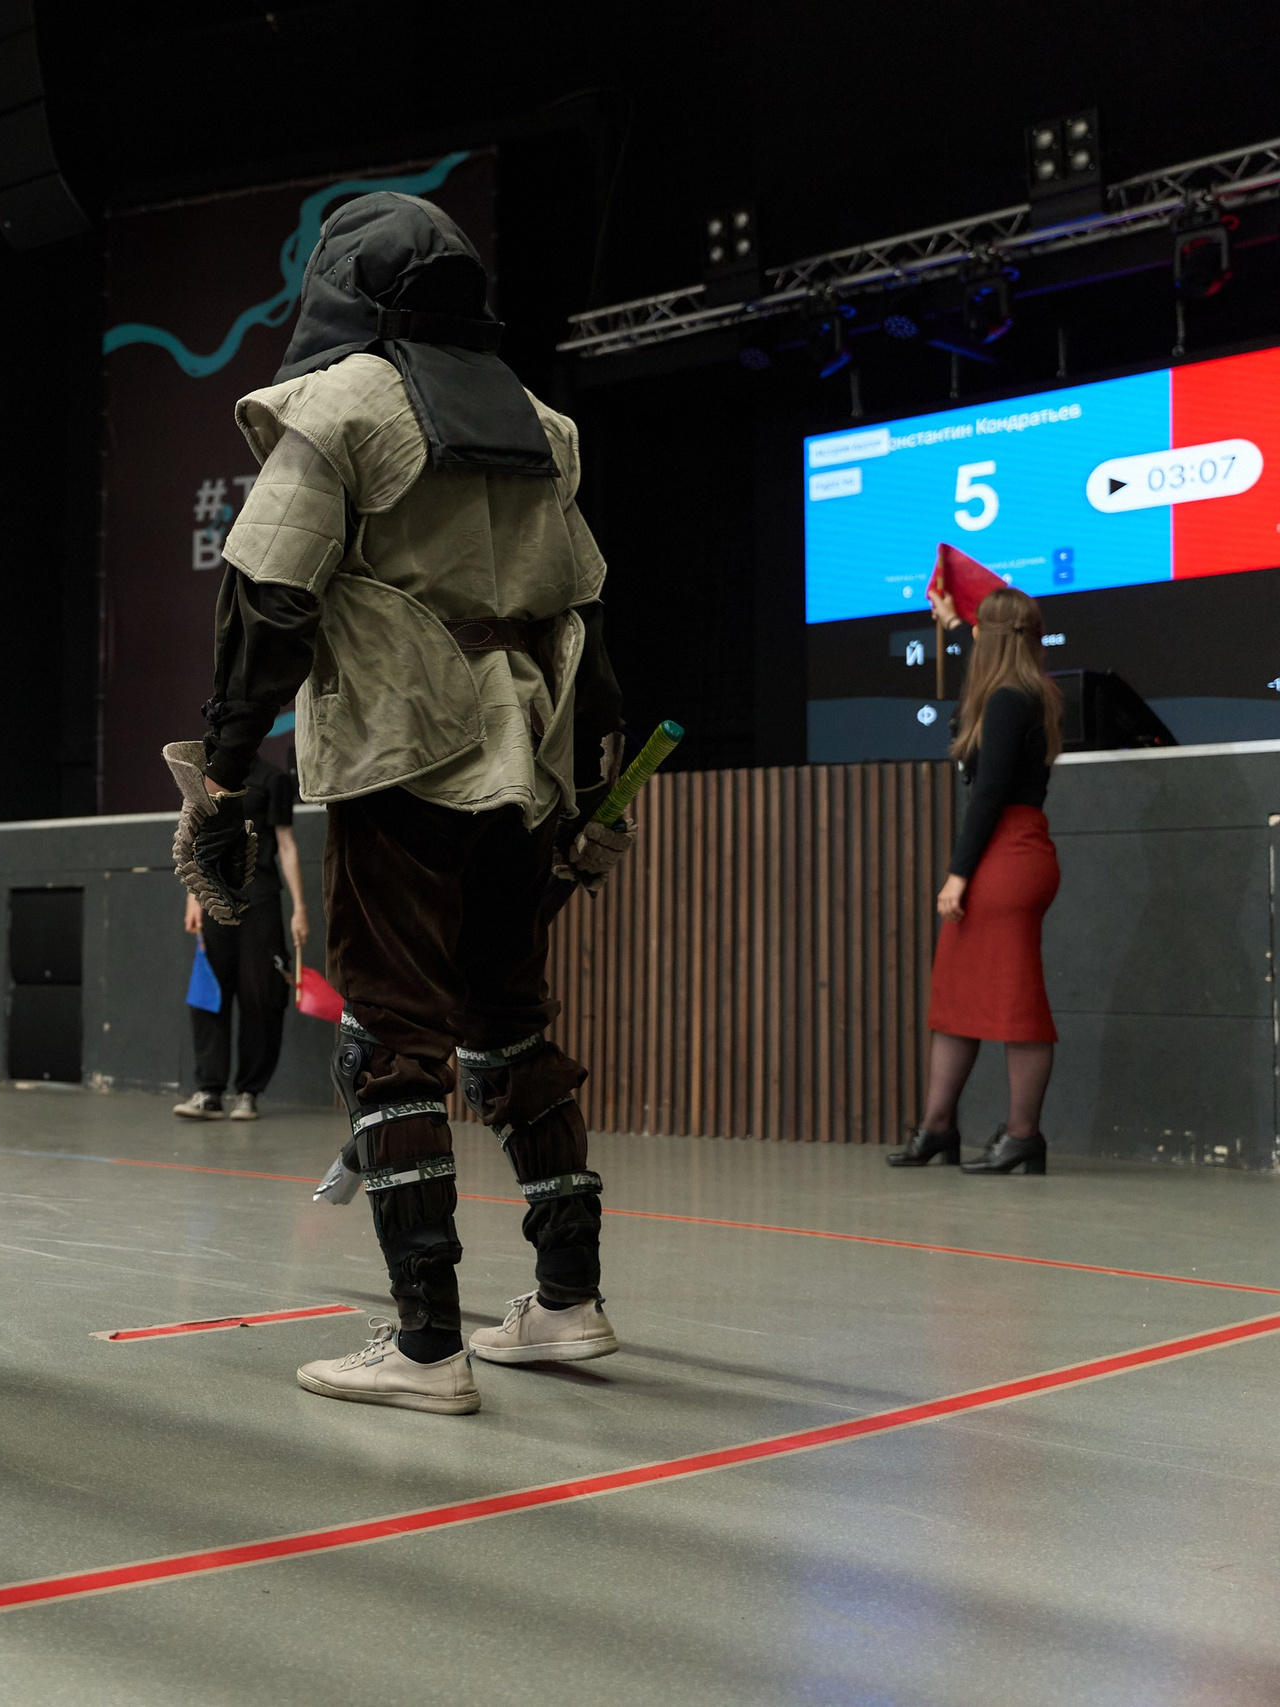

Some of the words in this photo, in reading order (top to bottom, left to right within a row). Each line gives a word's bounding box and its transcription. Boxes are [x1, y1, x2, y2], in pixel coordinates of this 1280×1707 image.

[888, 422, 973, 452] онстантин
[976, 403, 1081, 435] Кондратьев
[1147, 453, 1237, 493] 03:07
[954, 460, 1000, 532] 5
[501, 1034, 537, 1058] VEMAR
